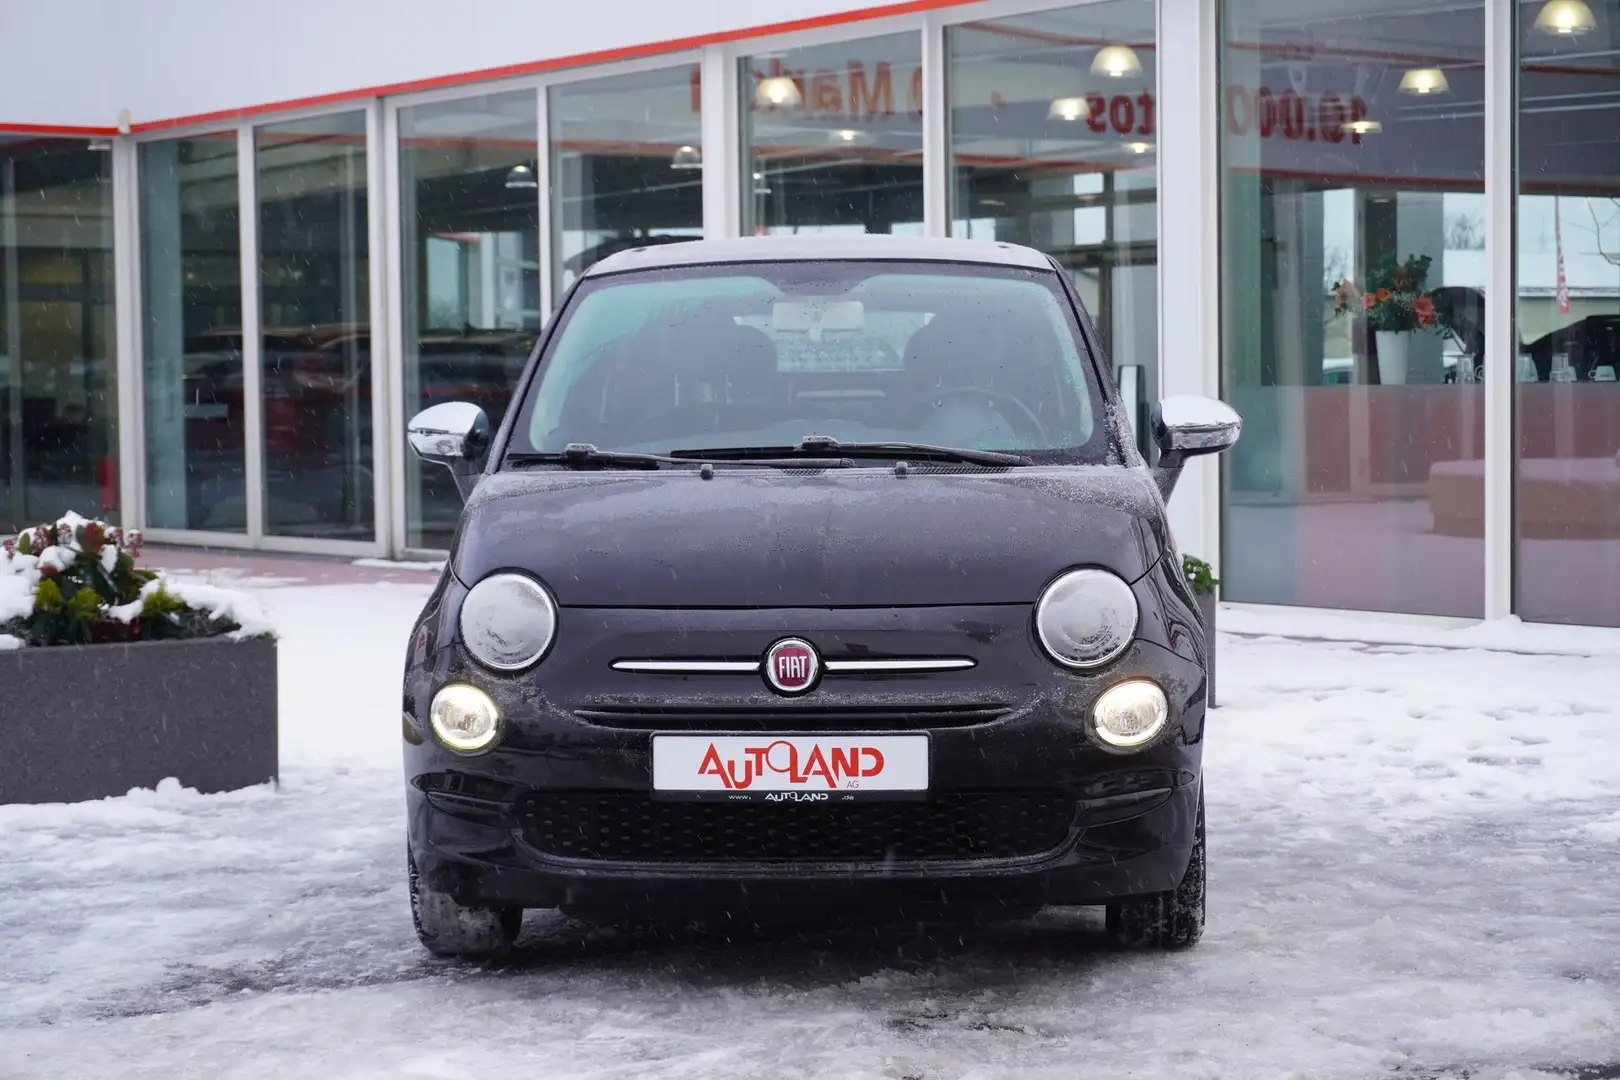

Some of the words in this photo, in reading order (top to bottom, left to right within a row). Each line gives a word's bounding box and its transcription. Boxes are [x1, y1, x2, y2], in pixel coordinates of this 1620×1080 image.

[779, 655, 807, 679] FIAT
[697, 740, 885, 789] AUTOLAND
[846, 780, 859, 789] AG
[765, 791, 829, 802] AUTOLAND
